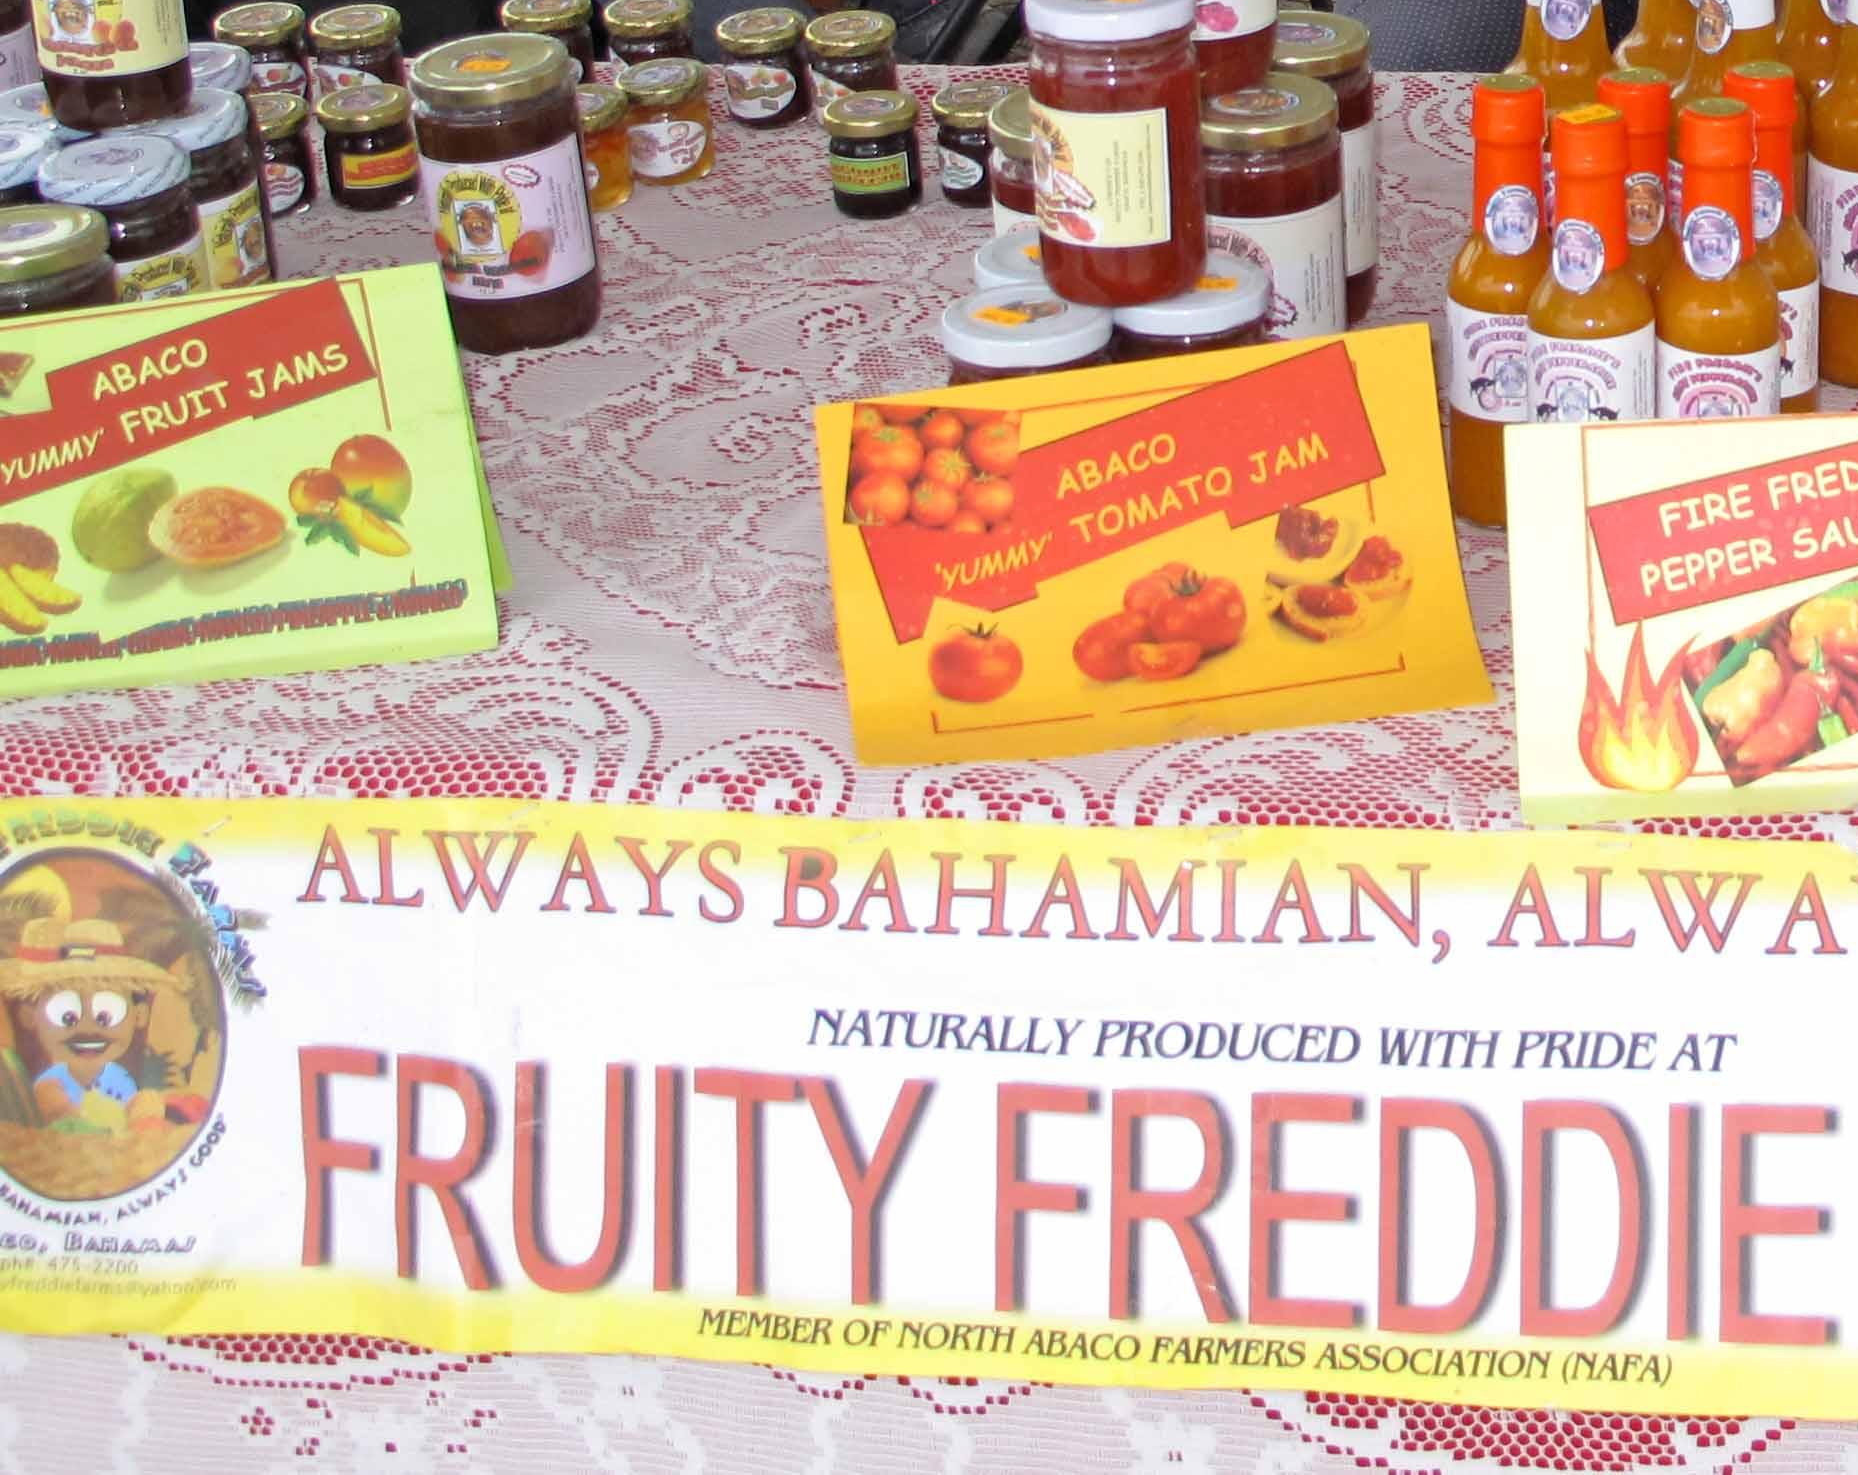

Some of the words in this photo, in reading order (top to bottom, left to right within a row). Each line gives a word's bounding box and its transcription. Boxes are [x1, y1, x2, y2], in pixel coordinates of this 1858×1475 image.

[92, 337, 210, 400] ABACO
[119, 379, 231, 444] FRUIT
[247, 342, 350, 400] JAMS
[1055, 432, 1178, 501] ABACO
[934, 532, 1055, 592] 'YUMMY'
[1069, 465, 1234, 545] TOMATO
[1248, 431, 1330, 486] JAM
[1658, 483, 1755, 539] FIRE
[1640, 538, 1776, 598] PEPPER
[296, 823, 746, 925] ALWAYS
[773, 842, 1454, 964] BAHAMIAN,
[807, 1007, 1090, 1059] NATURALLY
[1093, 1019, 1362, 1064] PRODUCED
[1378, 1028, 1499, 1070] WITH
[1512, 1029, 1659, 1072] PRIDE
[1667, 1031, 1739, 1073] AT
[297, 1043, 937, 1307] FRUITY
[993, 1080, 1842, 1348] FREDDIE
[698, 1306, 836, 1344] MEMBER
[842, 1317, 889, 1348] OF
[897, 1322, 1015, 1355] NORTH
[1023, 1333, 1143, 1364] ABACO
[1150, 1337, 1307, 1369] FARMERS
[1313, 1340, 1551, 1381] ASSOCIATION
[1561, 1350, 1674, 1388] (NAFA)
